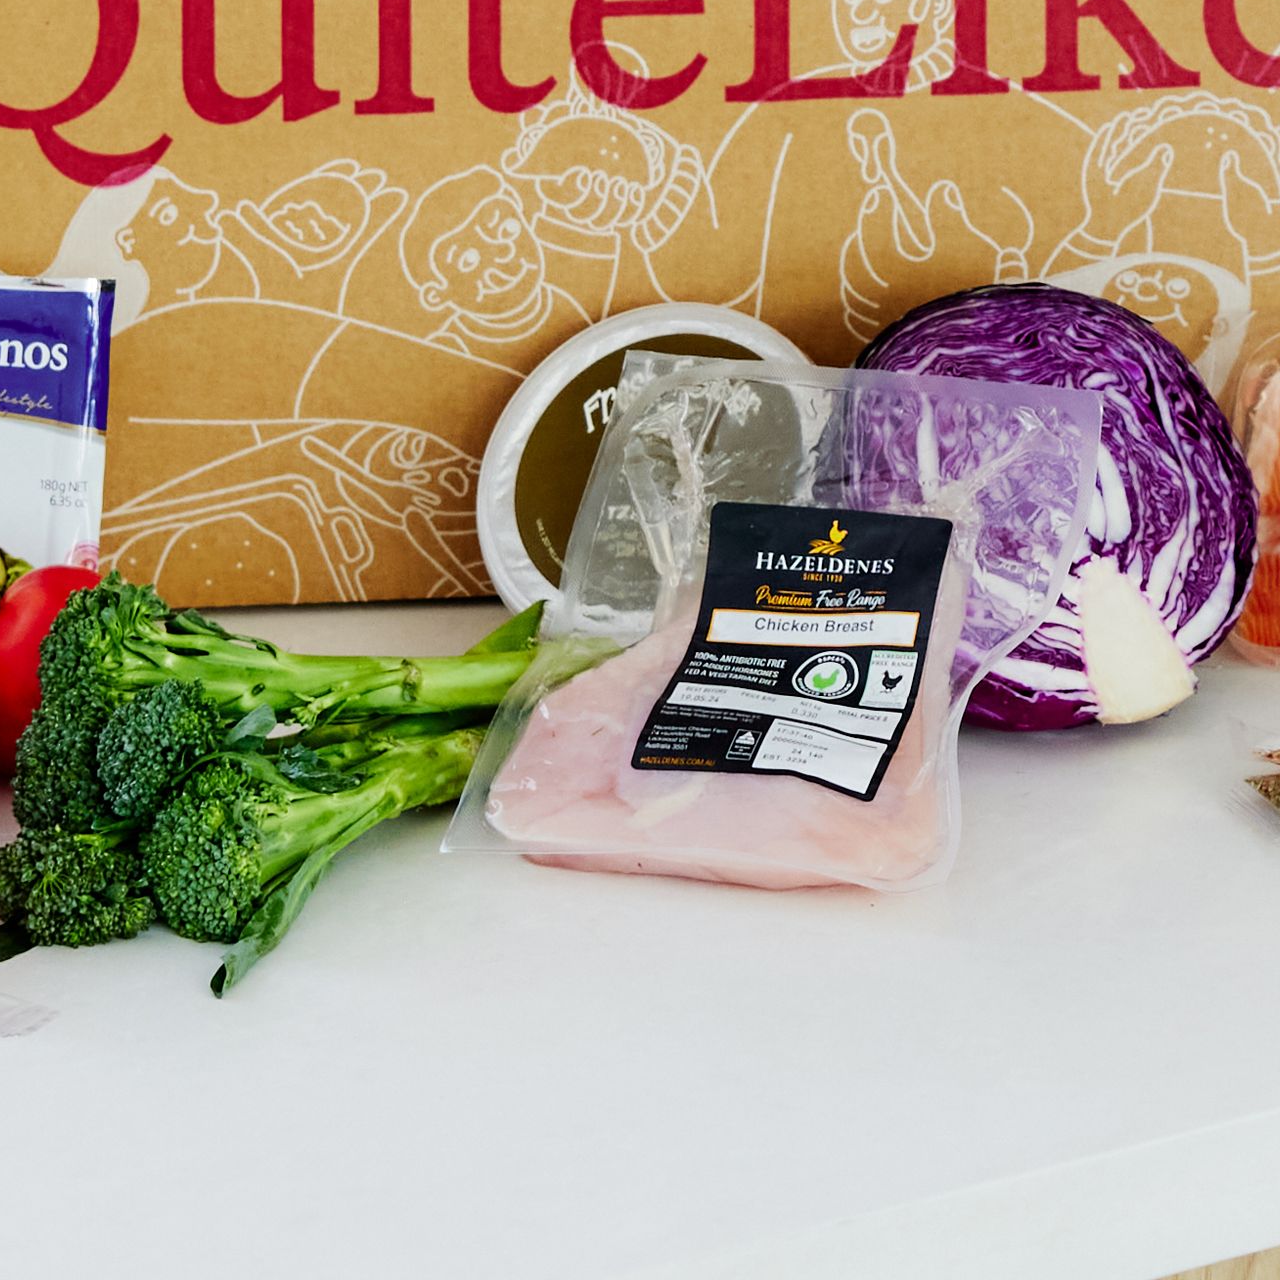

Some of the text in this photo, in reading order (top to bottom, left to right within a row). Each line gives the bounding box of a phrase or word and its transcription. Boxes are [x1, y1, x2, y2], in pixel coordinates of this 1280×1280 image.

[755, 552, 895, 575] HAZELDENES
[755, 584, 886, 611] Premium Free Range
[754, 617, 875, 633] Chicken Breast
